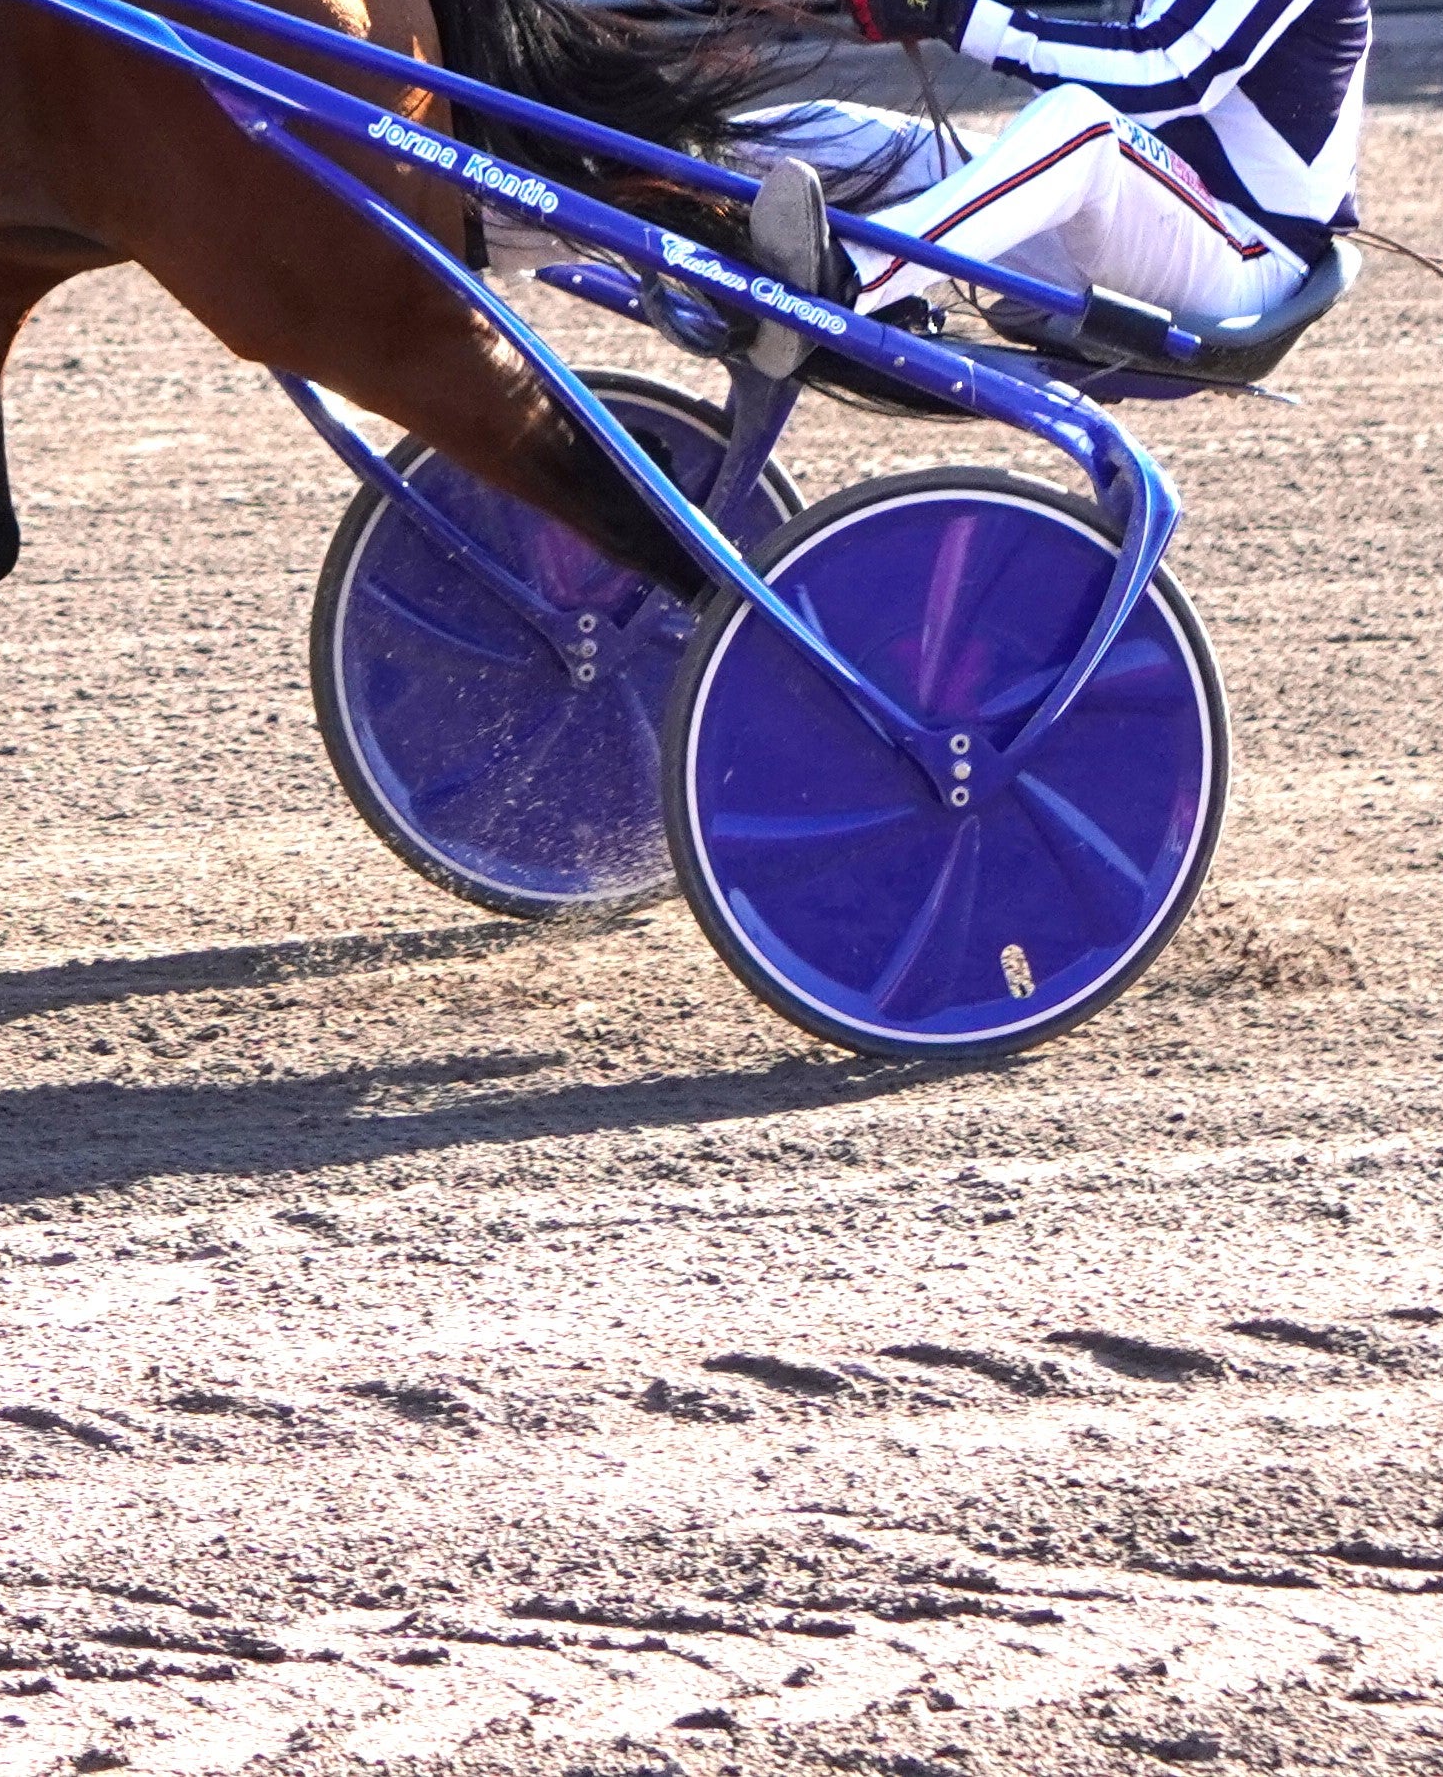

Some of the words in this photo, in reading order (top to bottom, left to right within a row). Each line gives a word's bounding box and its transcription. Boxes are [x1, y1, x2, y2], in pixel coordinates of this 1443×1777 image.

[368, 115, 458, 170] Jorma
[462, 153, 559, 213] Kontio
[660, 232, 748, 291] Custom
[750, 276, 847, 335] Chrono
